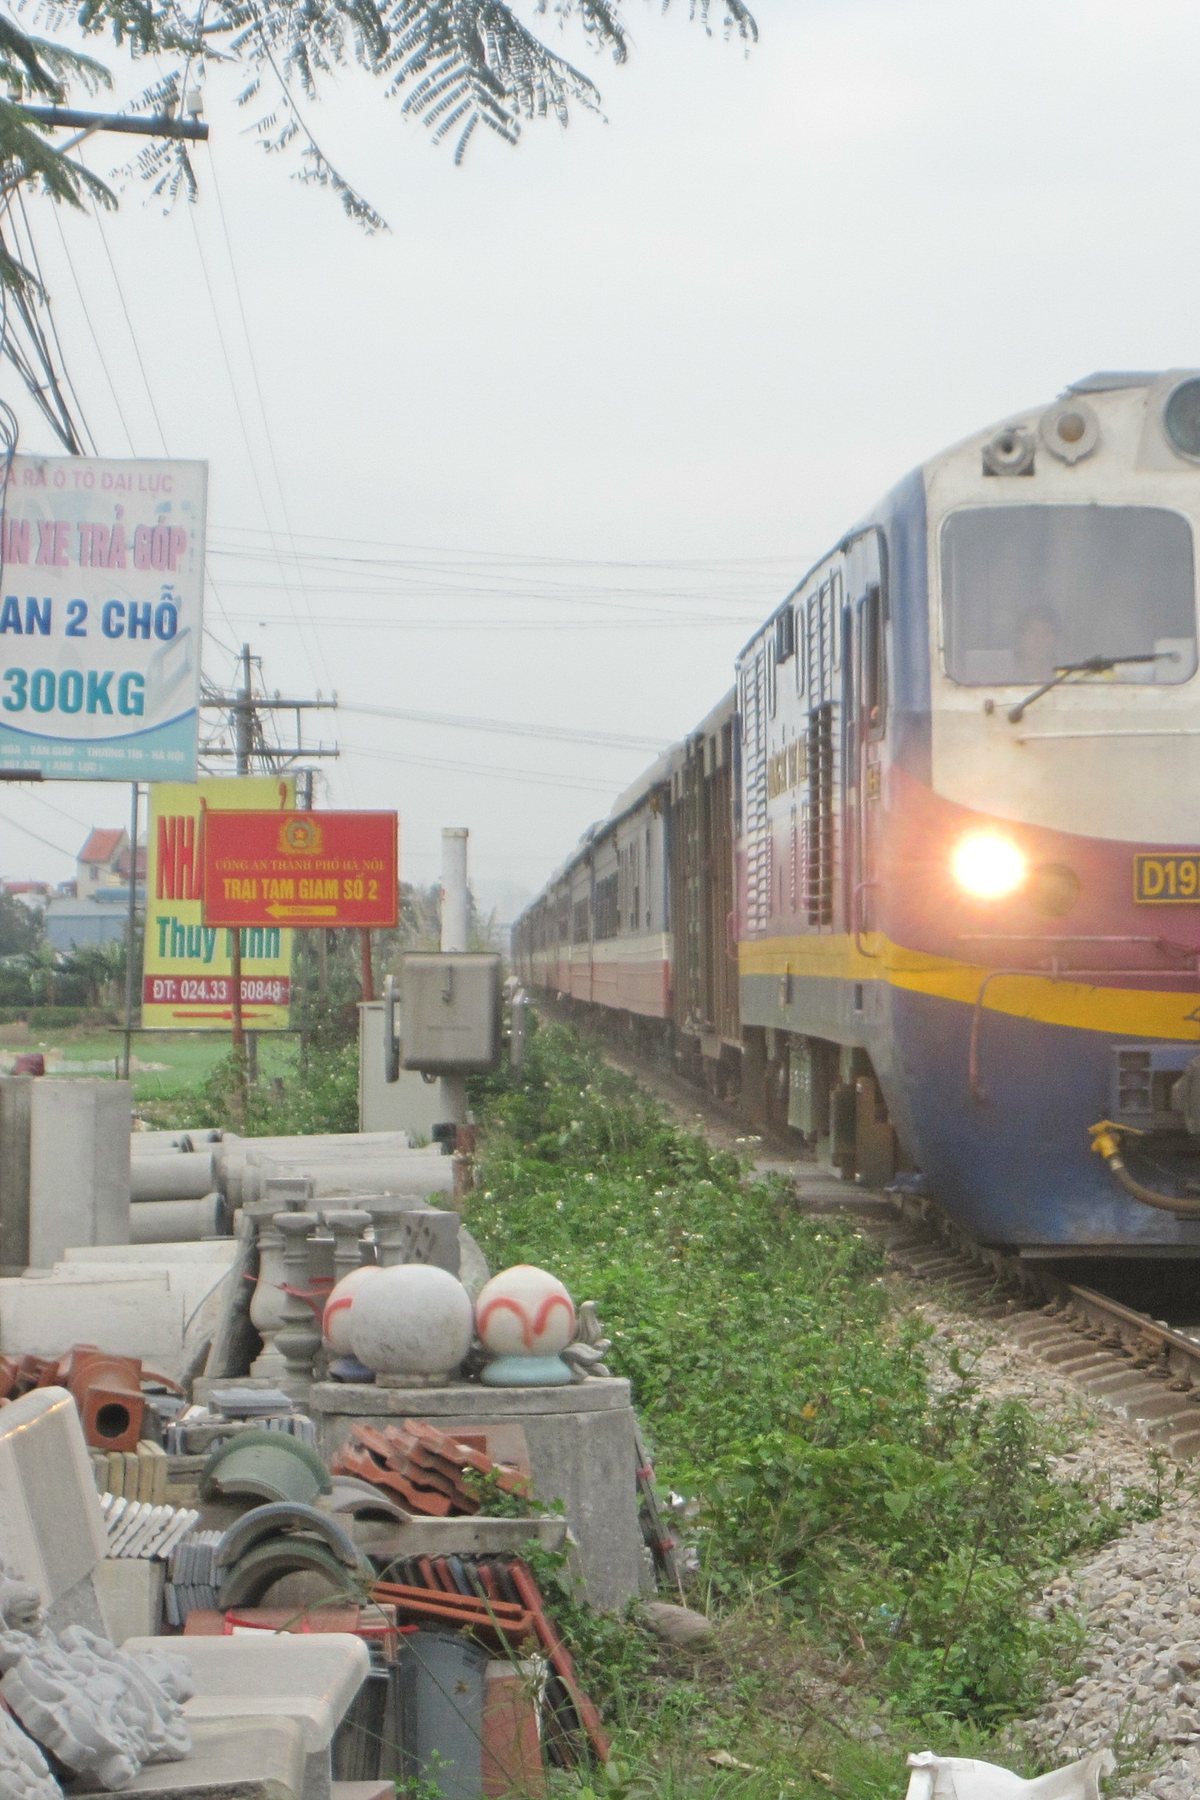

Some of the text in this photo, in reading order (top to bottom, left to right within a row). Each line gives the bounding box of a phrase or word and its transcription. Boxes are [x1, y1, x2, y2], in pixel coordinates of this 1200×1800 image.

[72, 466, 95, 489] TÔ
[35, 519, 71, 567] XE
[78, 504, 126, 570] TRẢ
[134, 515, 188, 571] GÓP
[65, 598, 89, 638] 2
[101, 584, 178, 641] CHỖ
[2, 667, 146, 717] 300KG
[216, 857, 248, 871] CÔNG
[252, 860, 268, 871] AN
[272, 857, 311, 871] THÀNH
[343, 857, 359, 871] HÀ
[363, 859, 385, 873] NỘI
[223, 872, 378, 903] TRẠI TẠM GIAM SỐ 2
[153, 979, 176, 999] ĐT:
